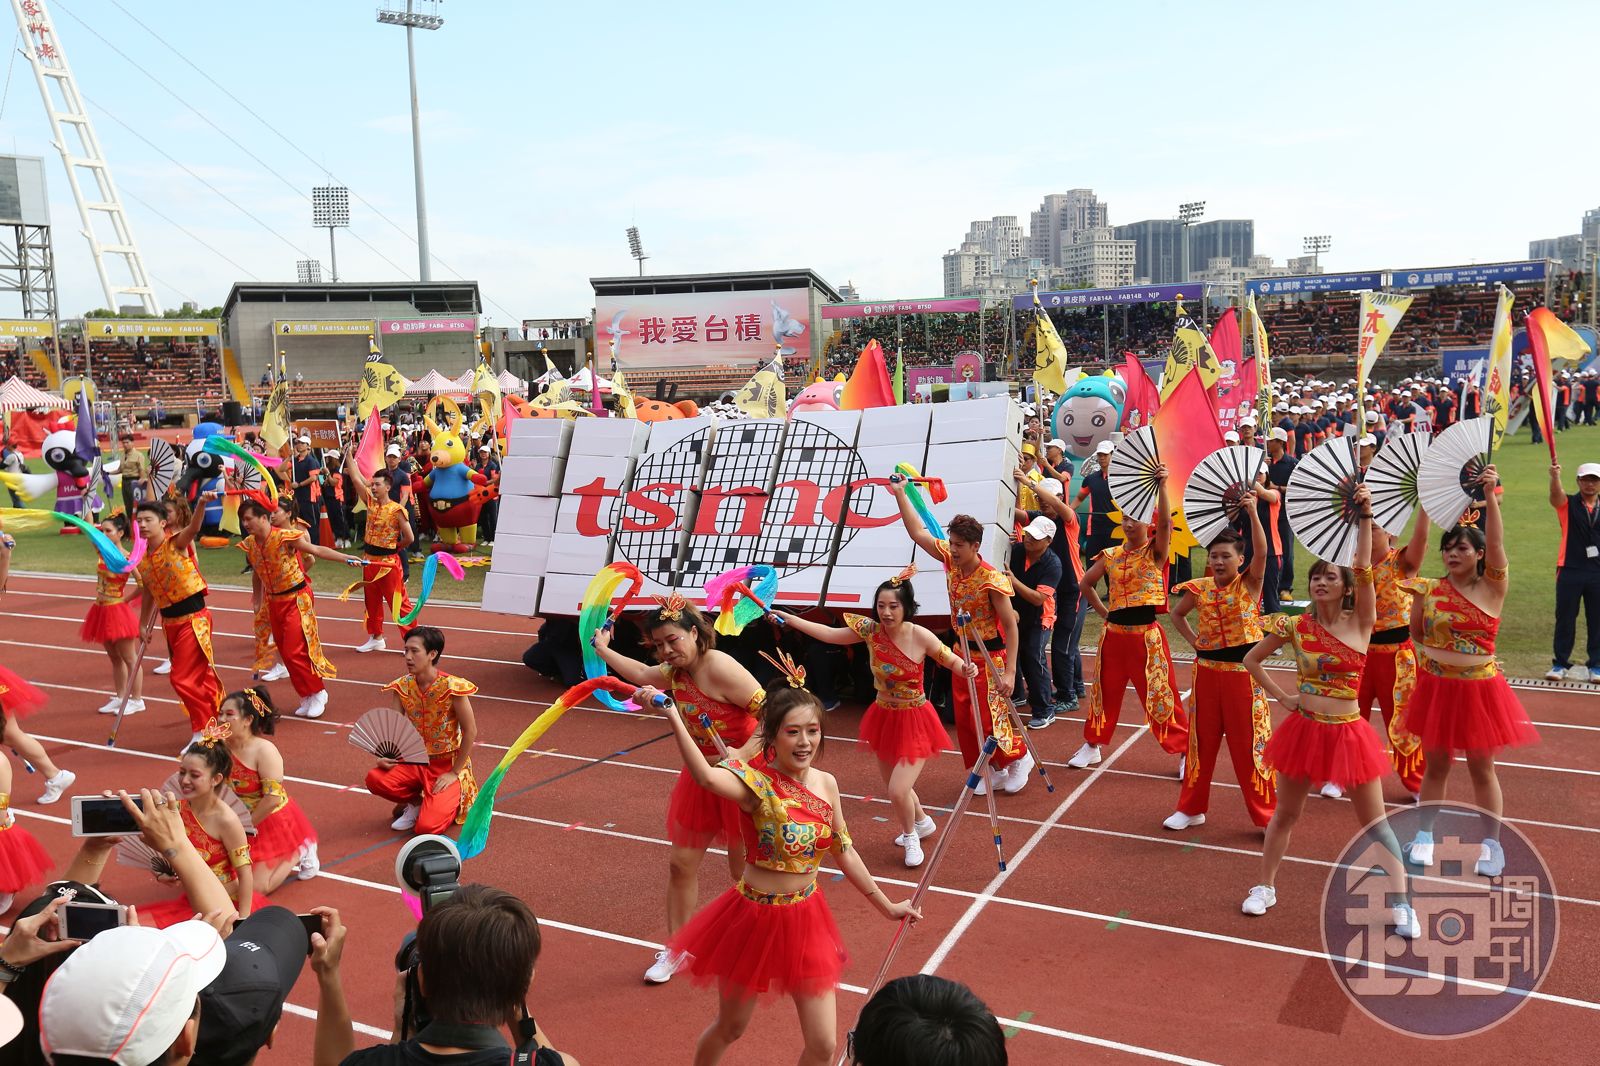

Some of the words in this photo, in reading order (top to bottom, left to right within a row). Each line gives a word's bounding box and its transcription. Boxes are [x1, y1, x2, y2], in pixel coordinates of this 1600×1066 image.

[1063, 295, 1087, 305] 黑皮隊
[1089, 295, 1113, 303] FAB14A
[1148, 291, 1160, 299] NJP
[638, 313, 762, 345] 我愛台積
[573, 476, 904, 537] tsmc
